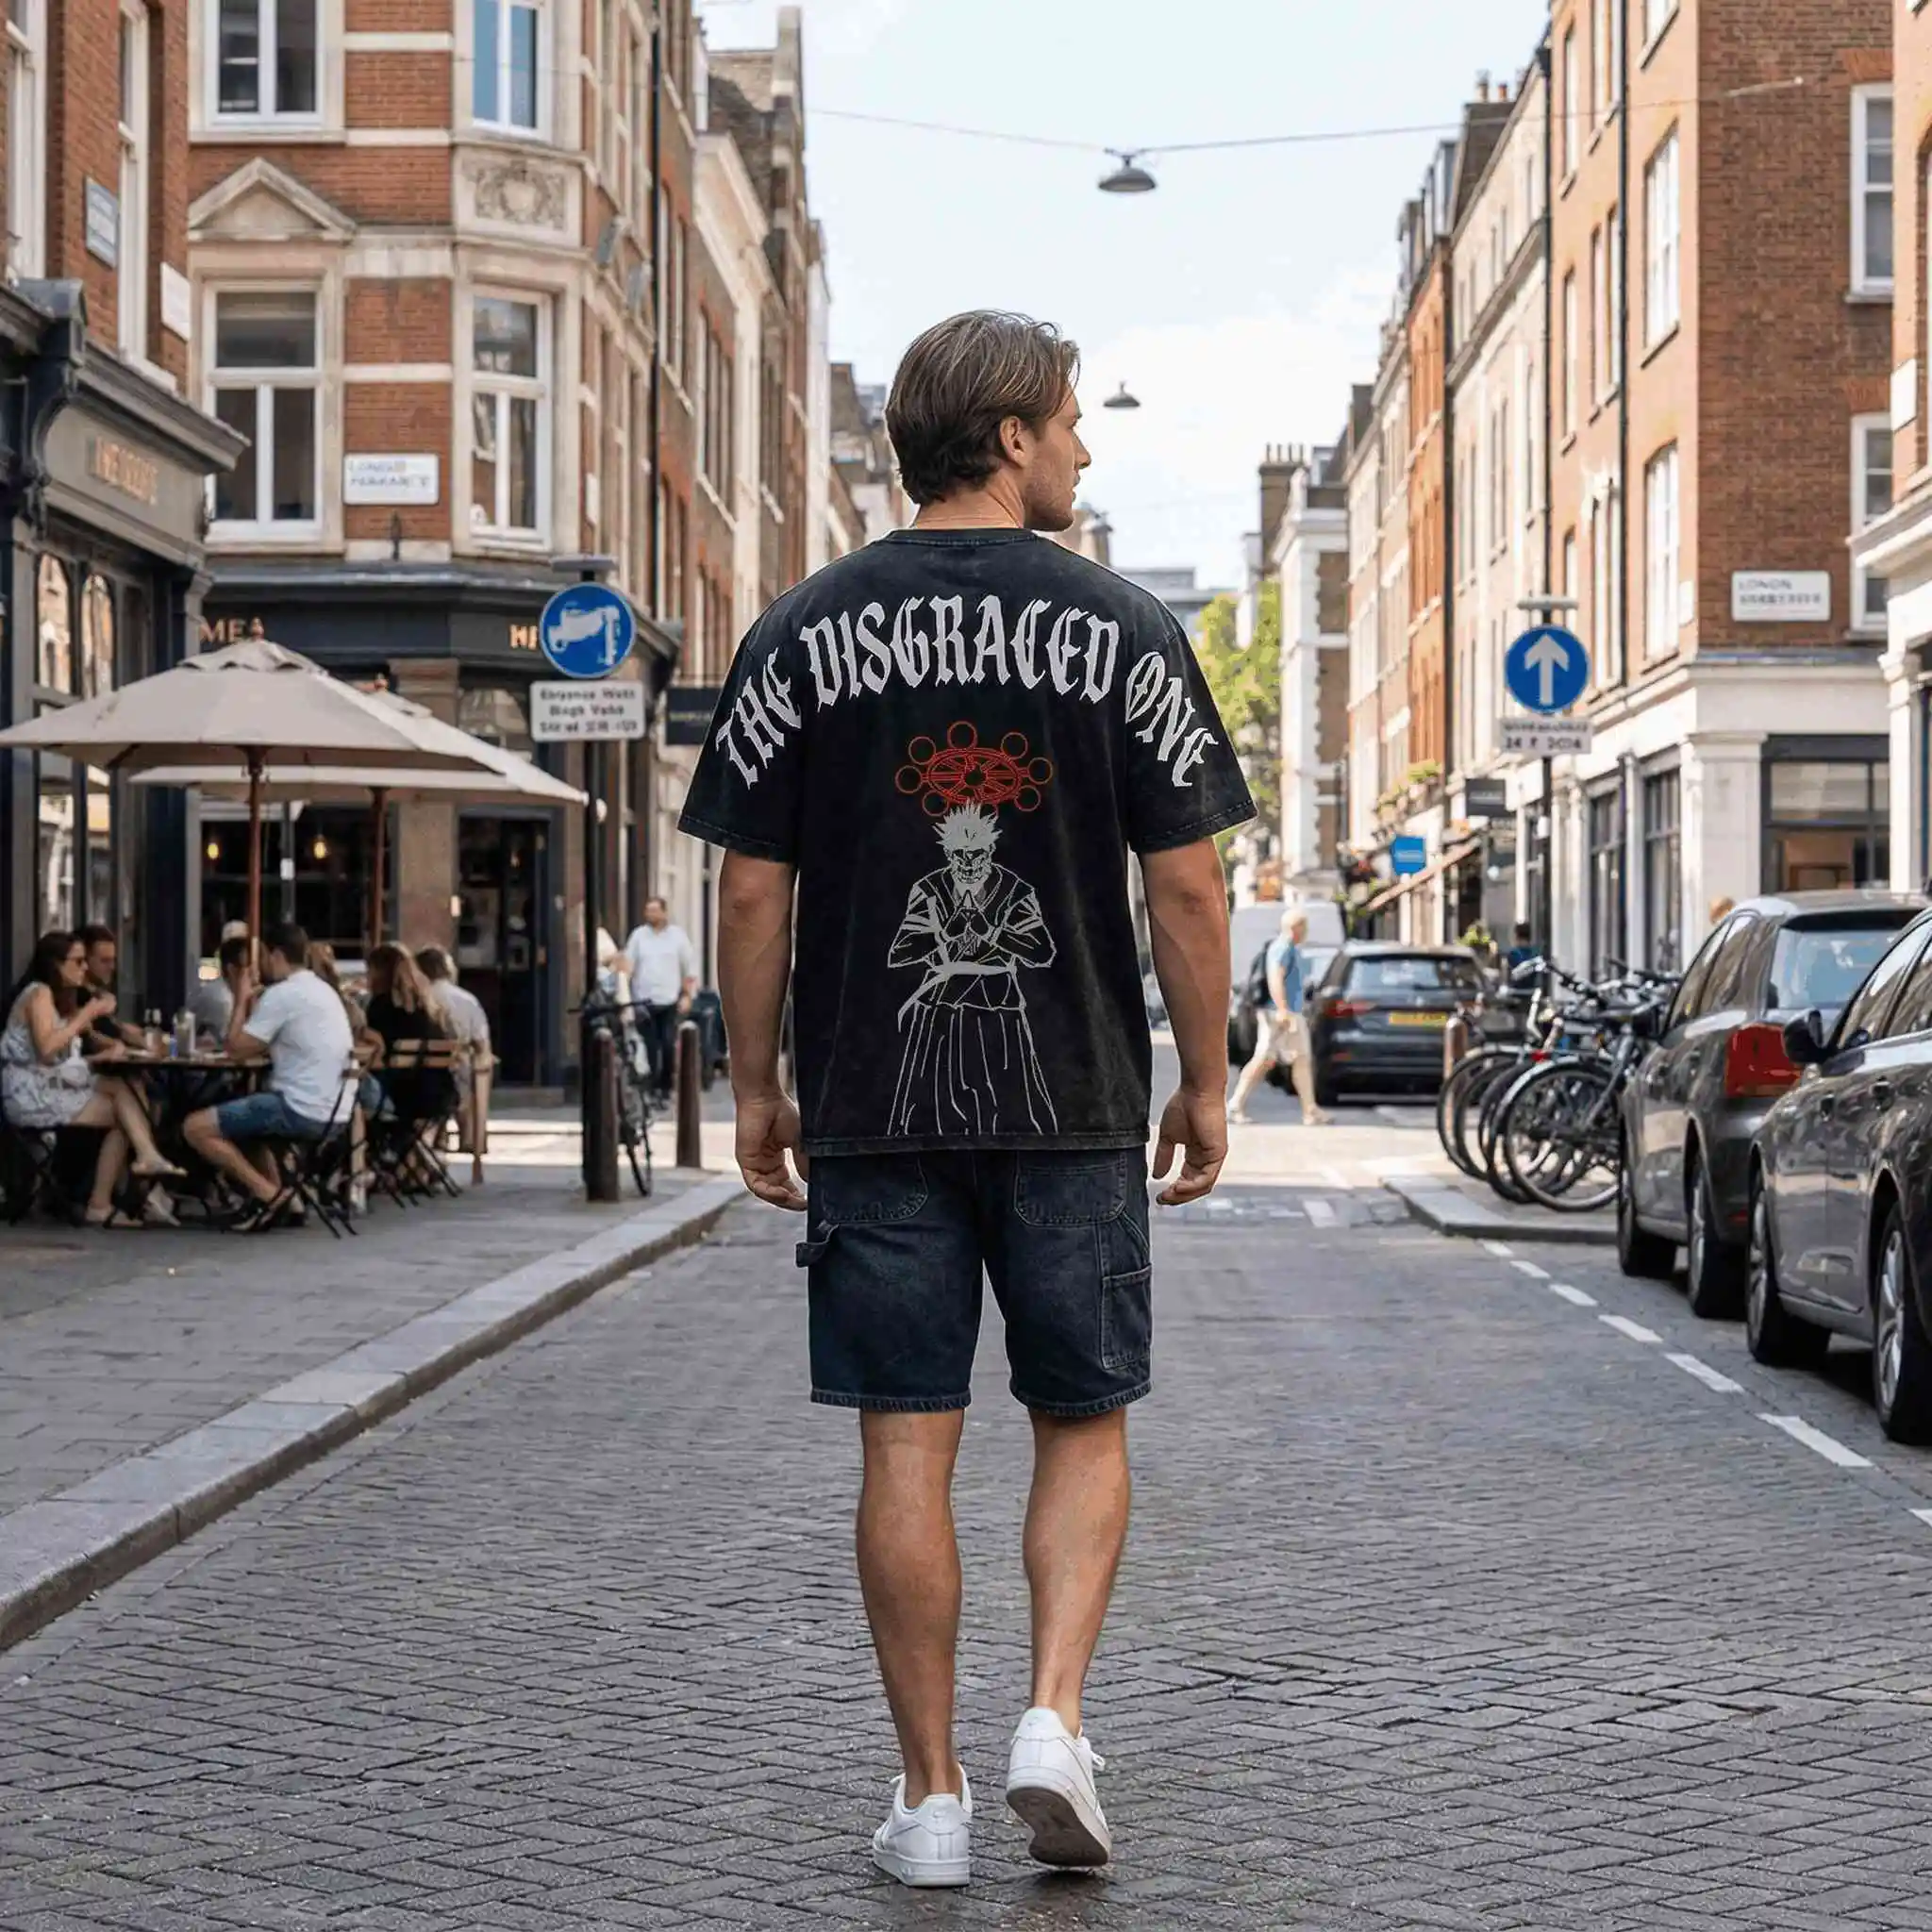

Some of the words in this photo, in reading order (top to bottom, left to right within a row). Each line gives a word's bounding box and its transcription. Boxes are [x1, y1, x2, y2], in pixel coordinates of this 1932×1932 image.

[715, 647, 802, 791] THE
[799, 593, 1120, 713] DISGRACED
[1125, 651, 1219, 787] ONE
